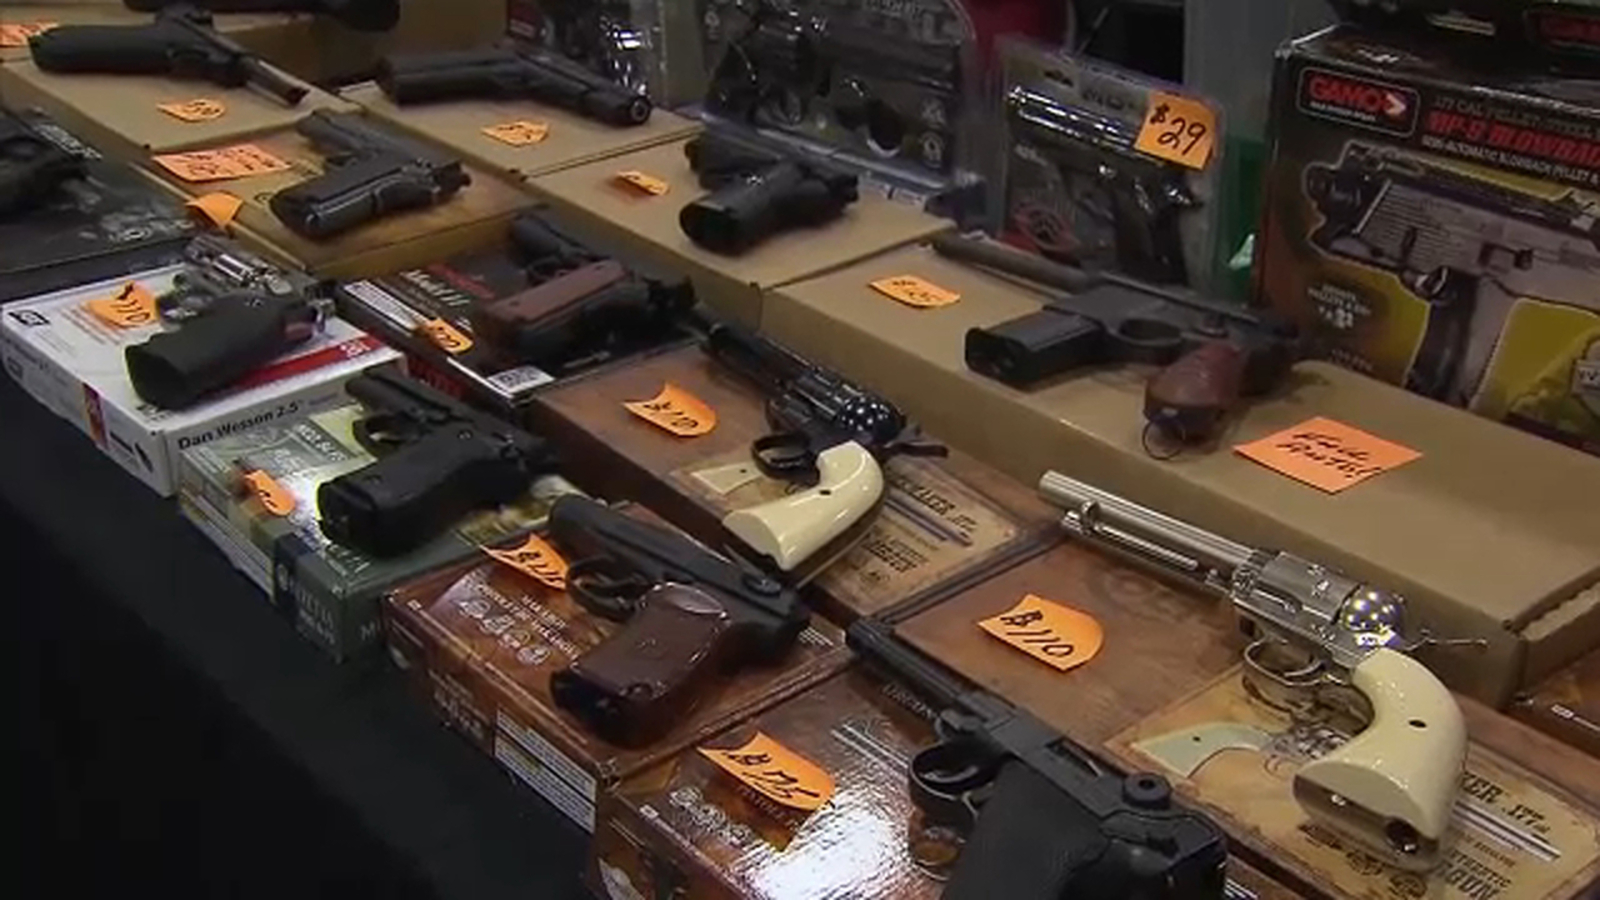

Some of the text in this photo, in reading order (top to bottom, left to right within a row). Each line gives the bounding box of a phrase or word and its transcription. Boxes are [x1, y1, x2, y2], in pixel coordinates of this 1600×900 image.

[1308, 76, 1382, 113] GAMO
[1150, 103, 1207, 156] $29
[177, 431, 213, 450] Dan
[216, 411, 275, 441] Wesson
[1000, 610, 1074, 658] $110
